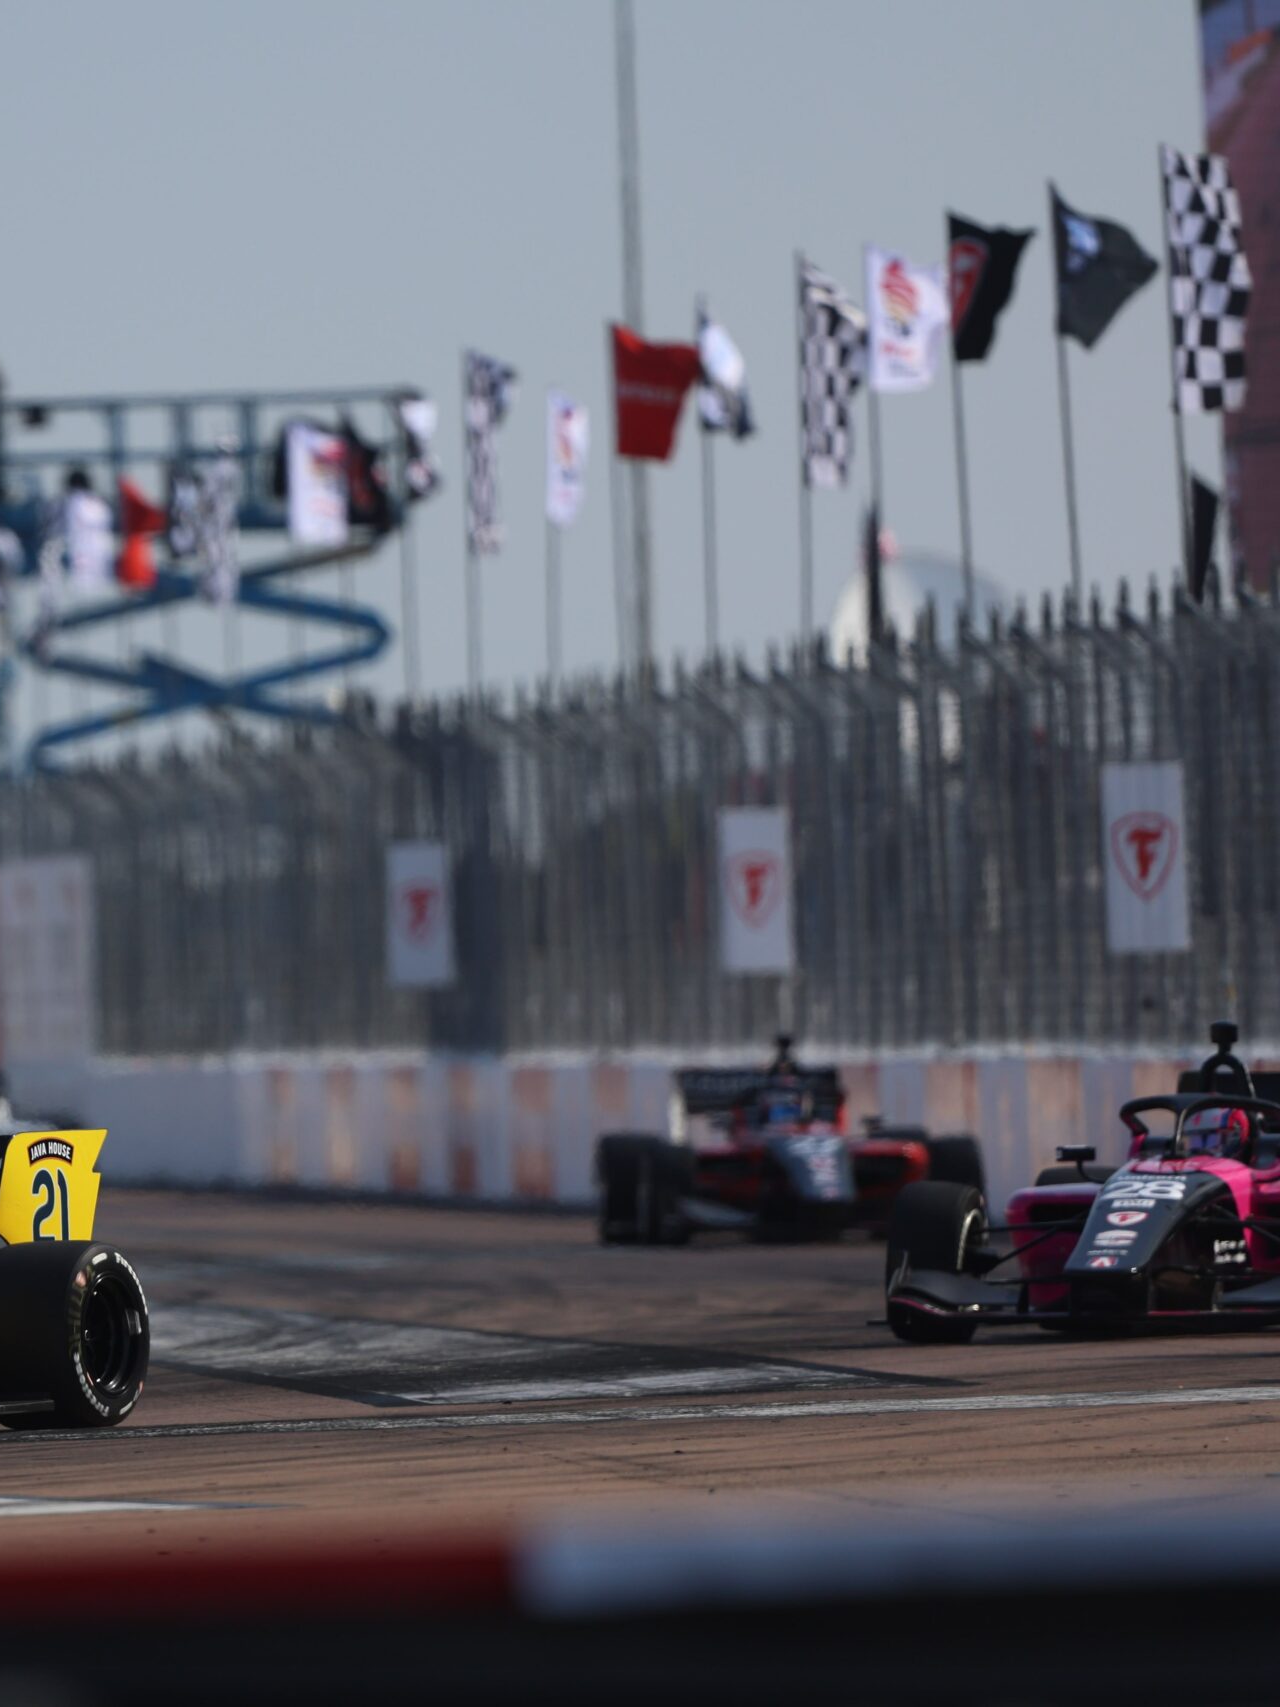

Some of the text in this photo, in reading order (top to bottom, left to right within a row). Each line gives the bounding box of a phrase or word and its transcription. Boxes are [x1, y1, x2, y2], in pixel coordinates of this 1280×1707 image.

[31, 1141, 71, 1158] JAVA HOUSE
[1101, 1181, 1186, 1200] 28
[32, 1169, 69, 1241] 21
